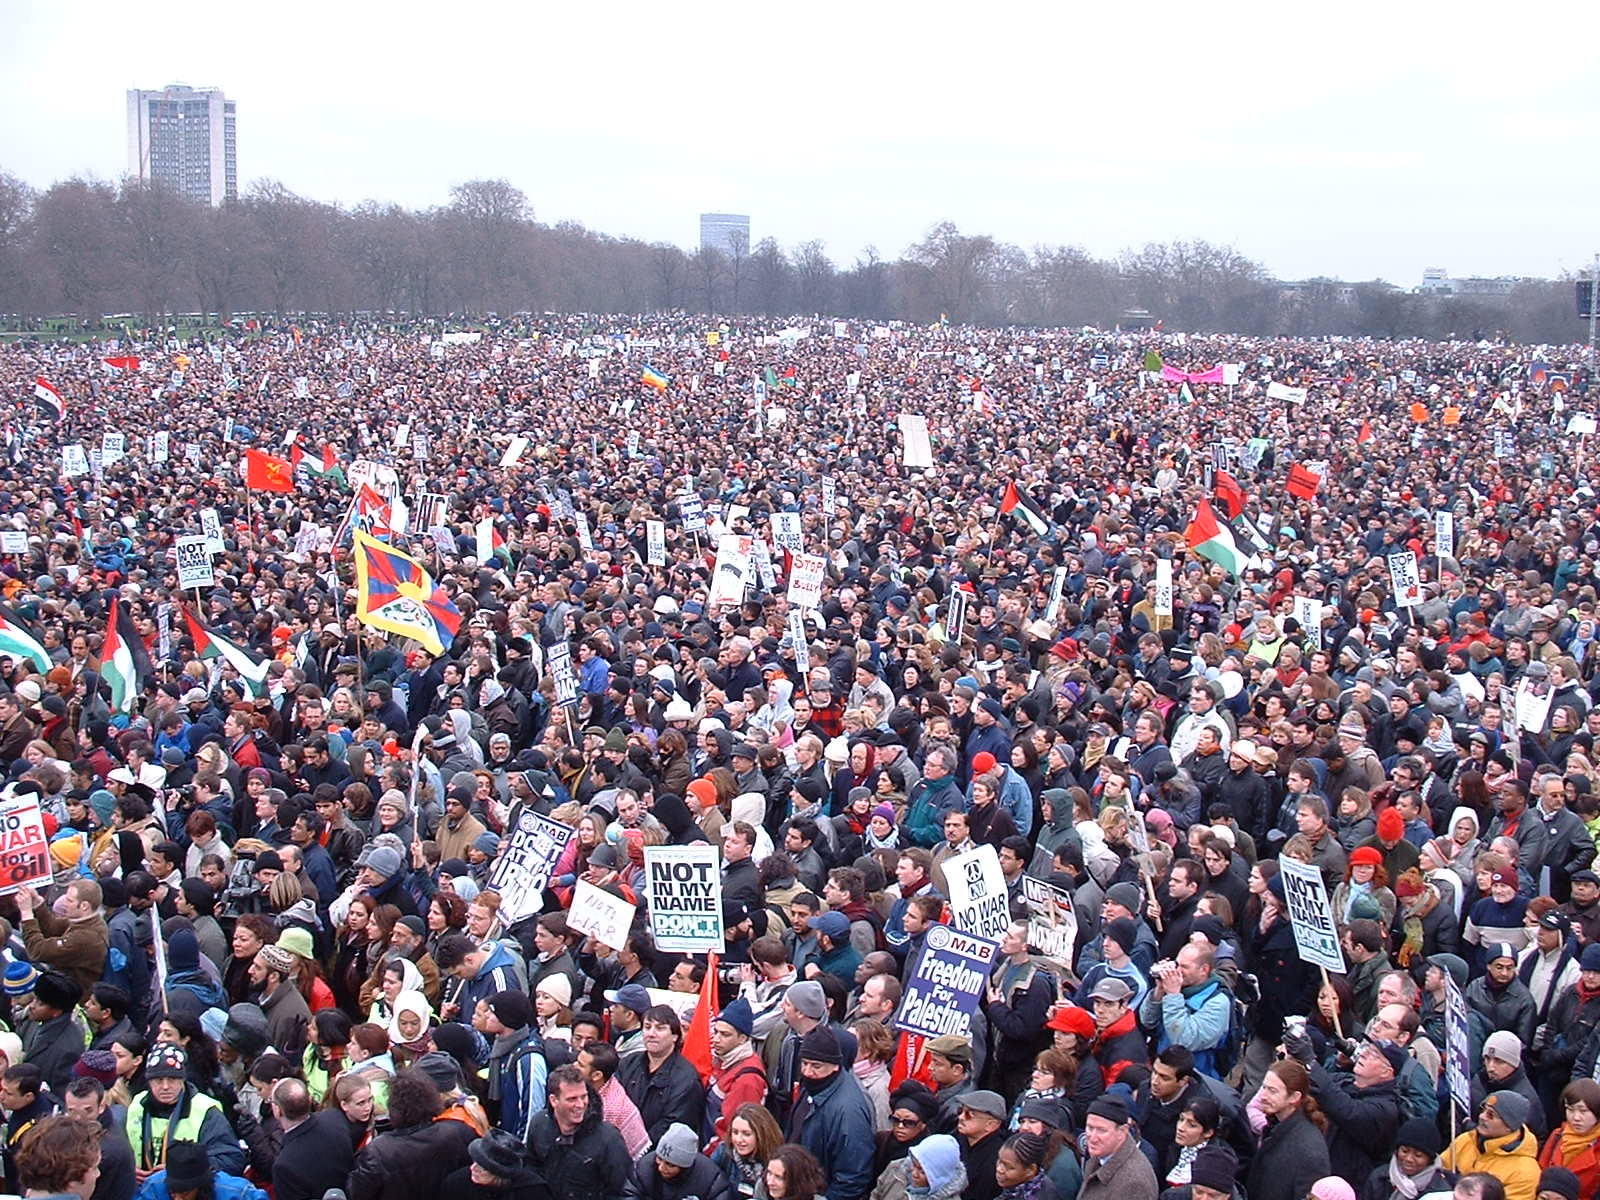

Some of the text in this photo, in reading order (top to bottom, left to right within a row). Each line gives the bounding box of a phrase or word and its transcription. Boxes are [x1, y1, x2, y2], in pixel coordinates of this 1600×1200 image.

[178, 543, 206, 556] NOT
[190, 552, 207, 561] MY
[180, 560, 209, 569] NAME
[651, 862, 713, 882] NOT
[653, 882, 713, 896] IN MY
[1284, 871, 1320, 901] NOT
[654, 897, 716, 911] NAME
[959, 893, 1006, 931] NO WAR
[1288, 890, 1325, 916] IN MY
[572, 911, 617, 941] WAR
[654, 914, 719, 931] DON'T
[980, 912, 1010, 938] IRAQ
[1291, 905, 1331, 931] NAME
[951, 937, 991, 960] MAB
[917, 949, 984, 996] Freedom
[932, 984, 955, 1001] For
